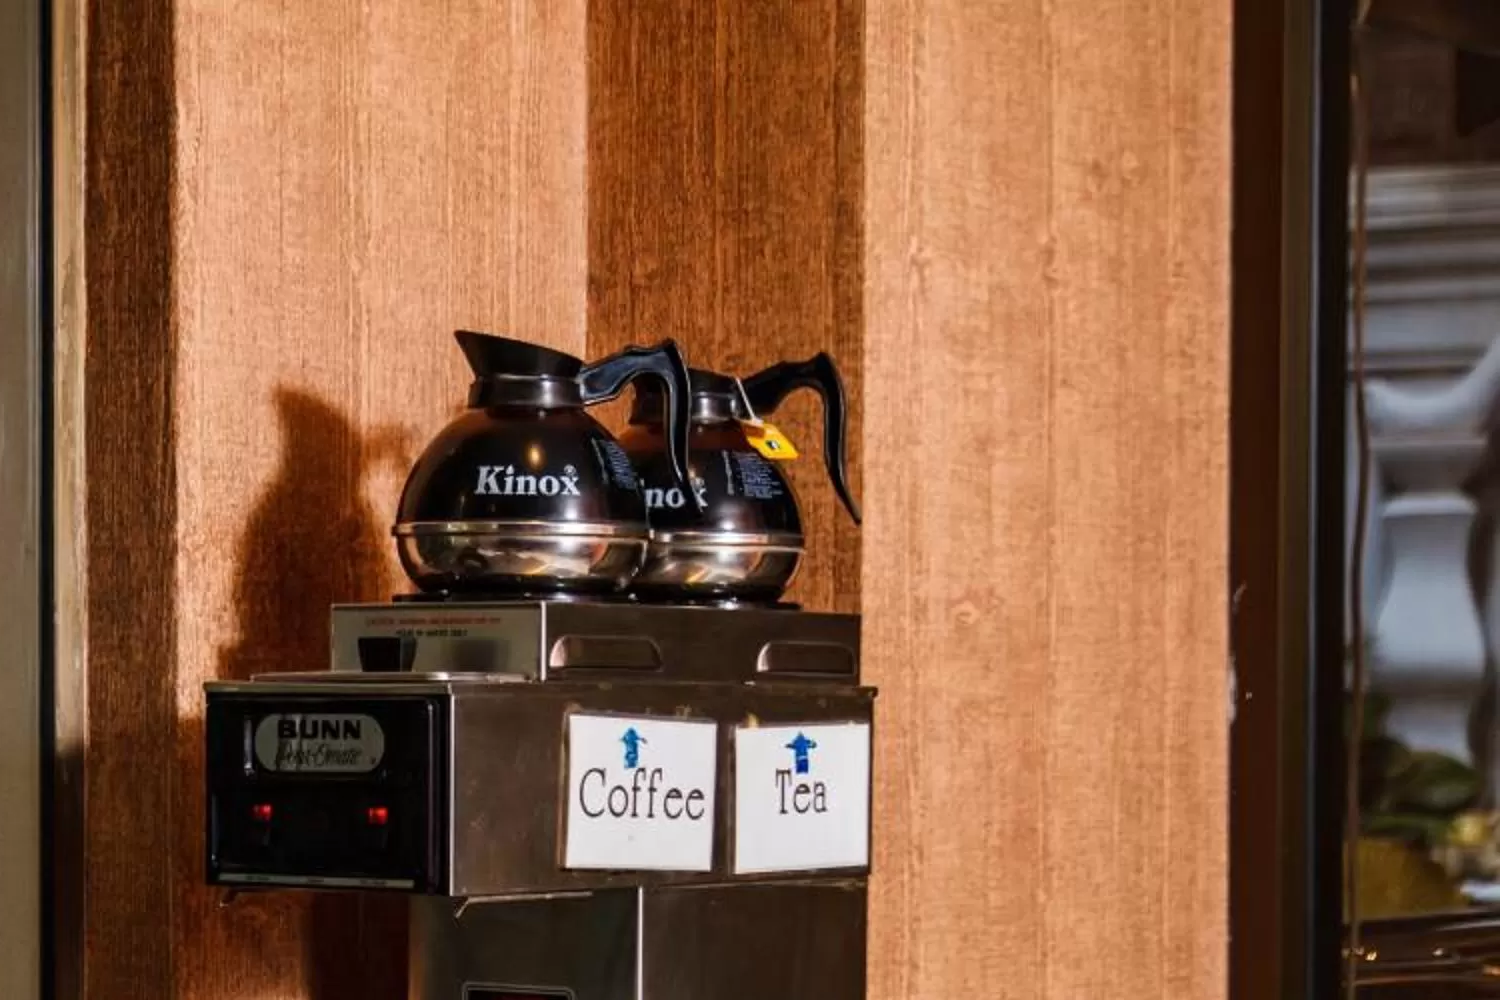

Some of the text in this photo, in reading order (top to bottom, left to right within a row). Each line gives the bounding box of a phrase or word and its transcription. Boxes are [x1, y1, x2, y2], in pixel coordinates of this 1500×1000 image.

[474, 464, 581, 497] Kinox
[278, 719, 361, 739] BUNN
[579, 767, 705, 820] Coffee
[775, 768, 828, 815] Tea
